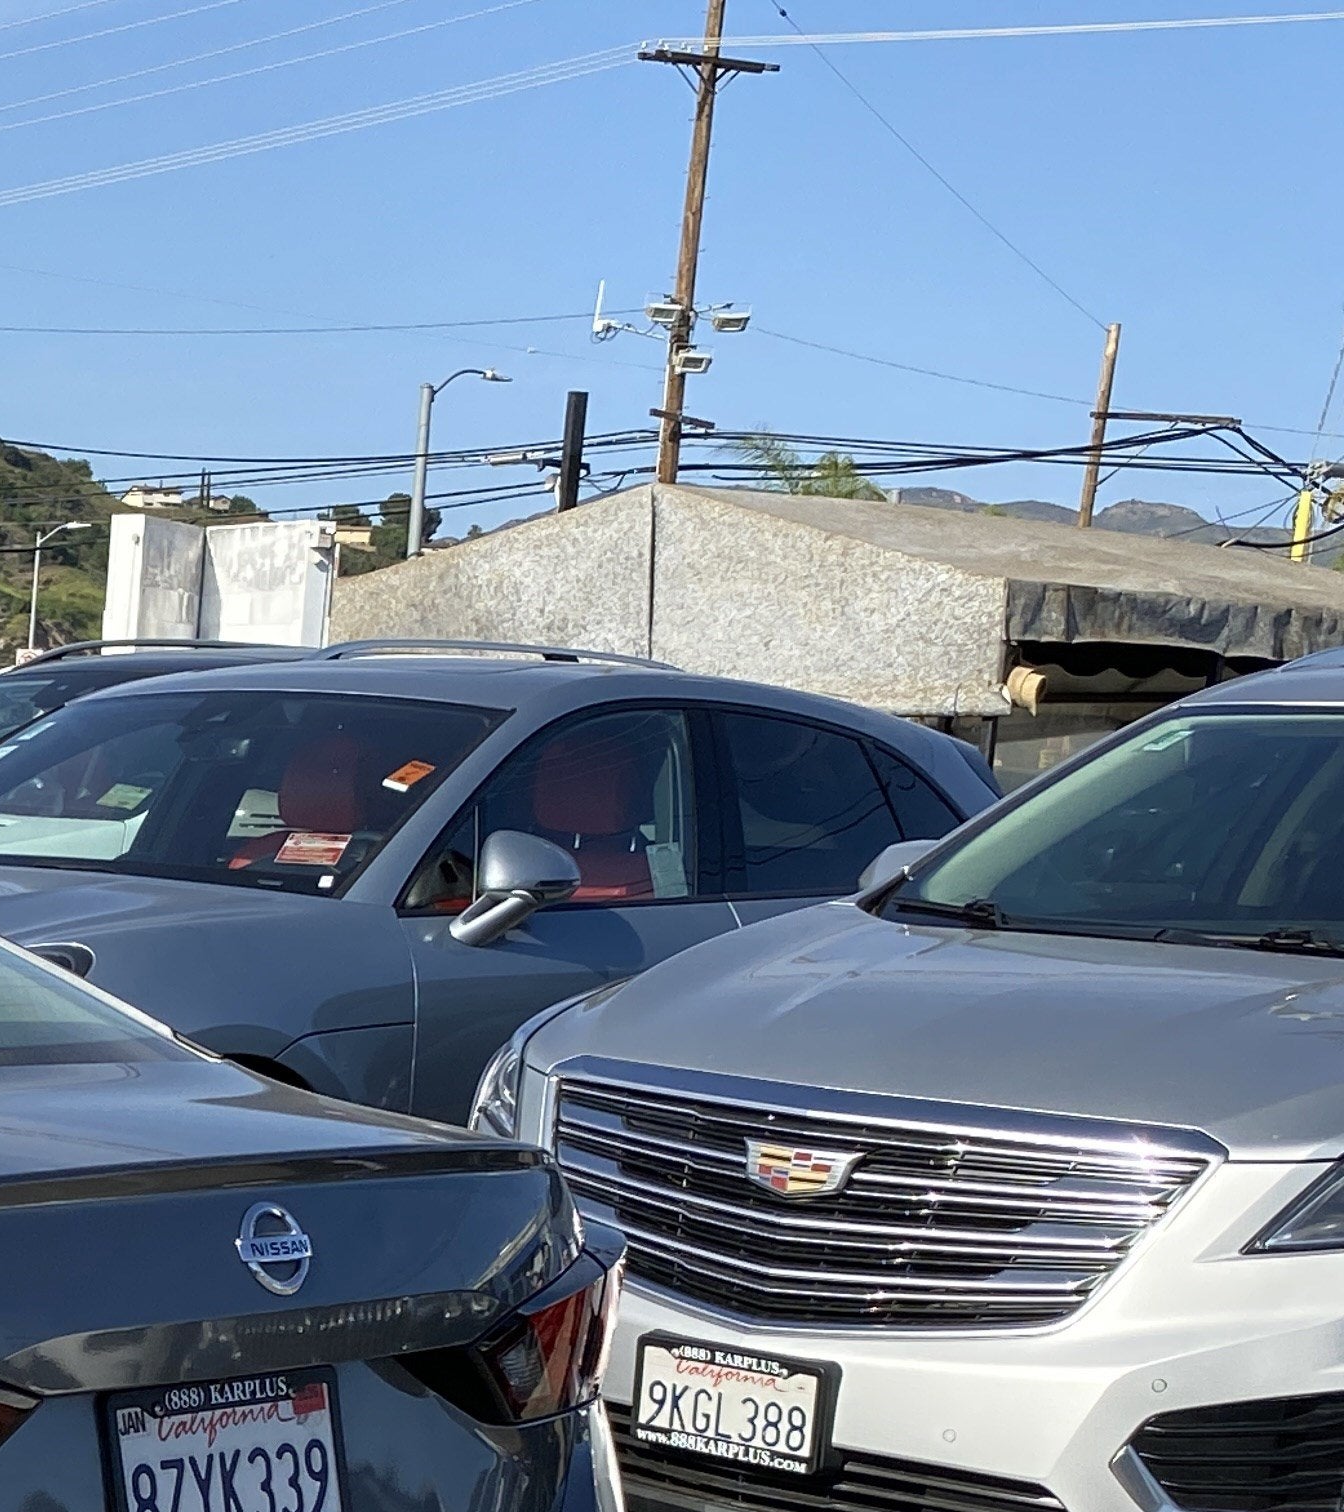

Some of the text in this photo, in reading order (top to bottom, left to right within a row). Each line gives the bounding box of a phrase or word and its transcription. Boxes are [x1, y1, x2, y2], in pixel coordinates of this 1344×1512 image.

[250, 1240, 309, 1257] NISSAN
[675, 1359, 790, 1393] California
[679, 1345, 780, 1375] (888) KARPLUS
[165, 1387, 205, 1410] (888)
[209, 1377, 287, 1404] KARPLUS
[118, 1411, 146, 1436] JAN
[157, 1402, 295, 1448] California
[647, 1379, 807, 1452] 9KGL388
